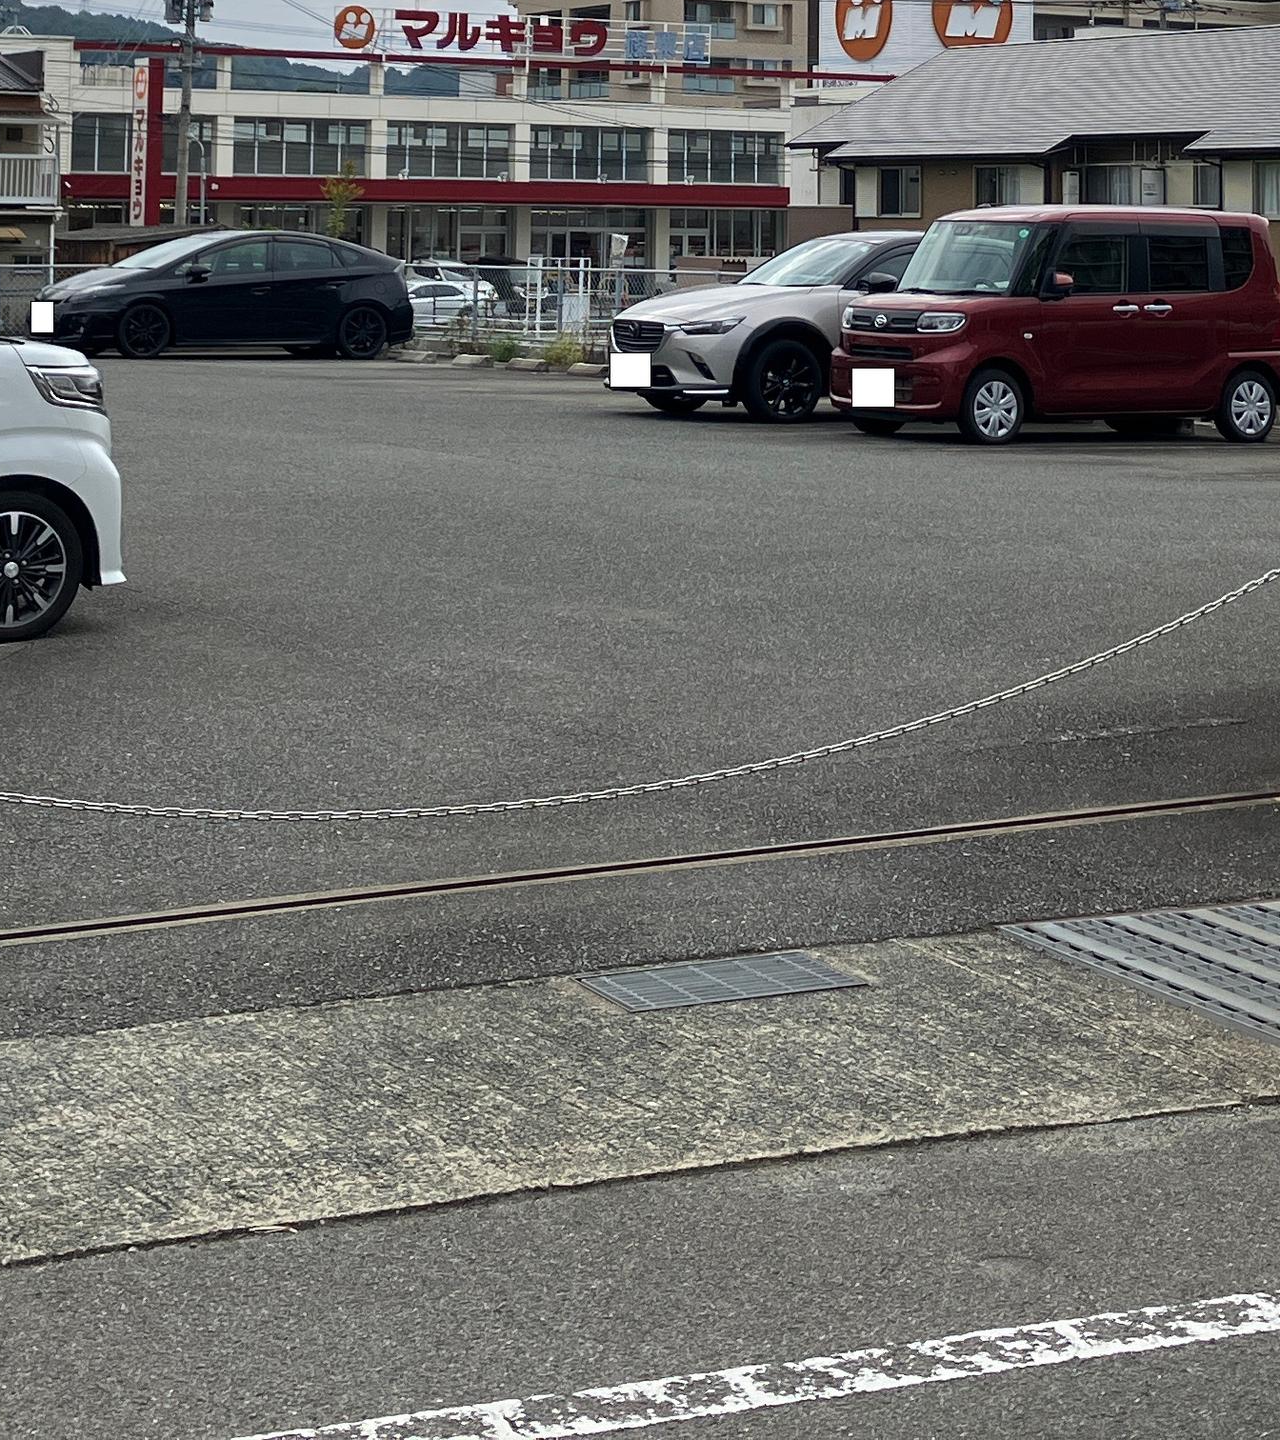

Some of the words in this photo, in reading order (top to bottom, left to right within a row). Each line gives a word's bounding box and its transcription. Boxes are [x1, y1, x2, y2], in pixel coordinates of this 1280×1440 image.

[395, 9, 608, 56] マルキョウ
